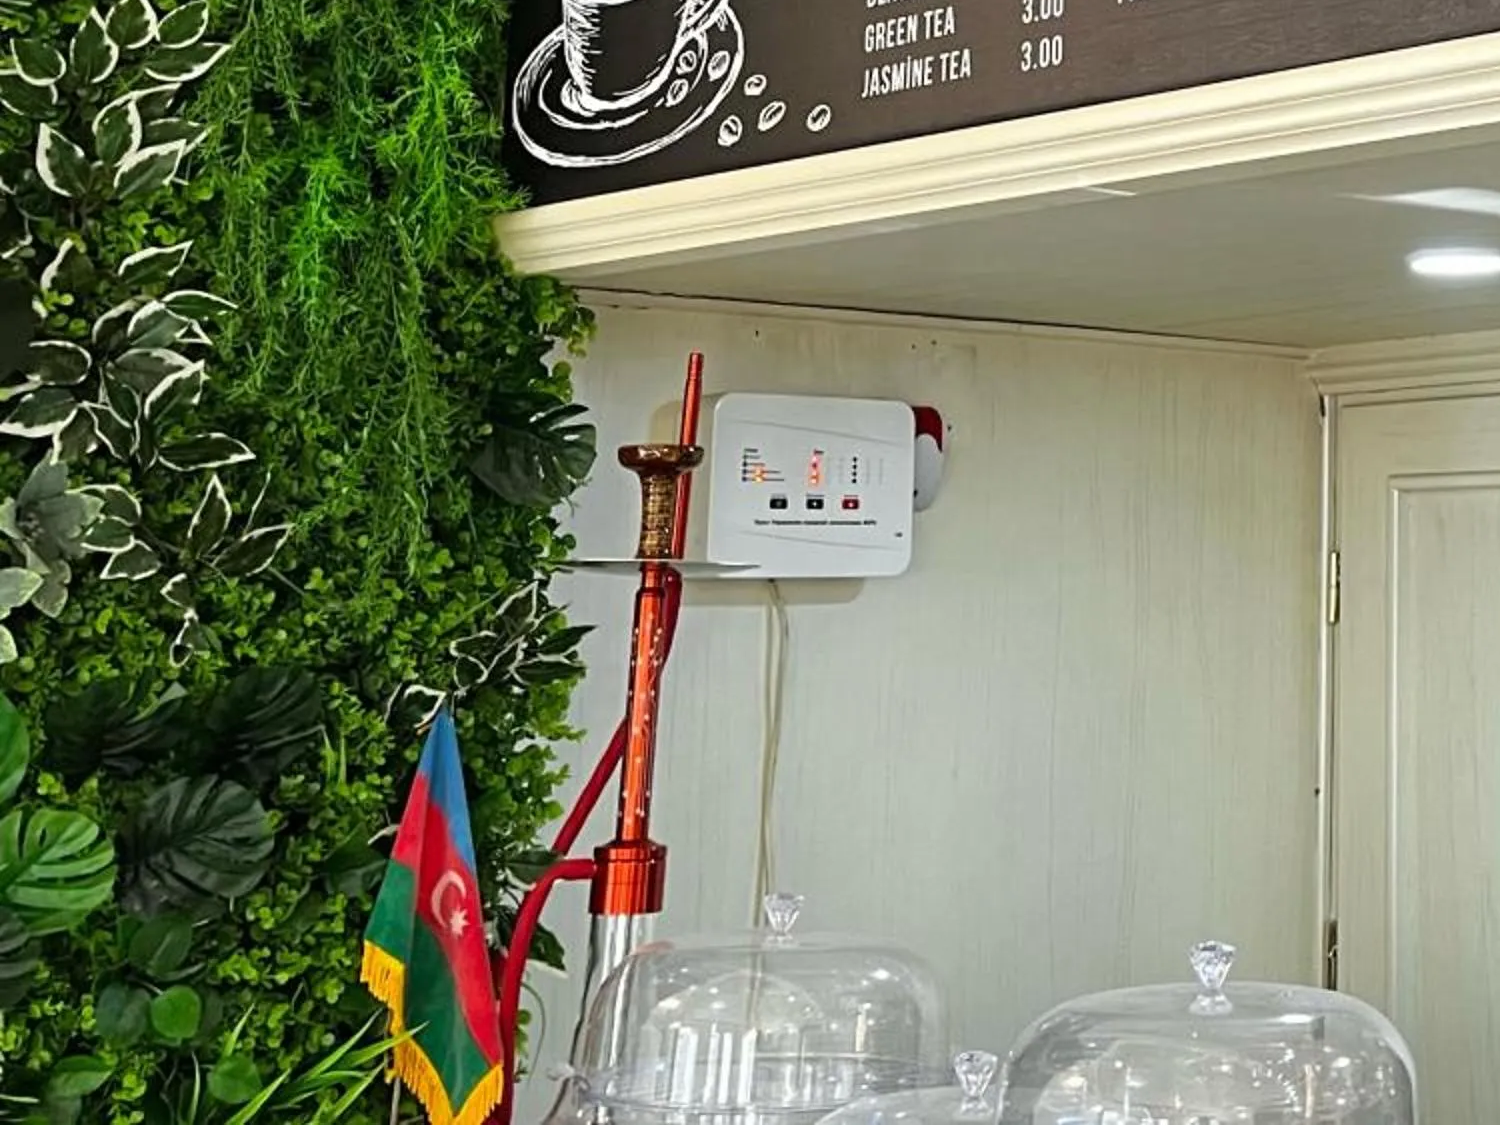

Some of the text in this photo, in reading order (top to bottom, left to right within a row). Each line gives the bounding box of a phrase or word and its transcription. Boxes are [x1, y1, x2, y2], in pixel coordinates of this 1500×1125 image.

[864, 5, 955, 53] GREEN TEA
[939, 48, 971, 82] TEA
[1020, 34, 1063, 72] 3.00
